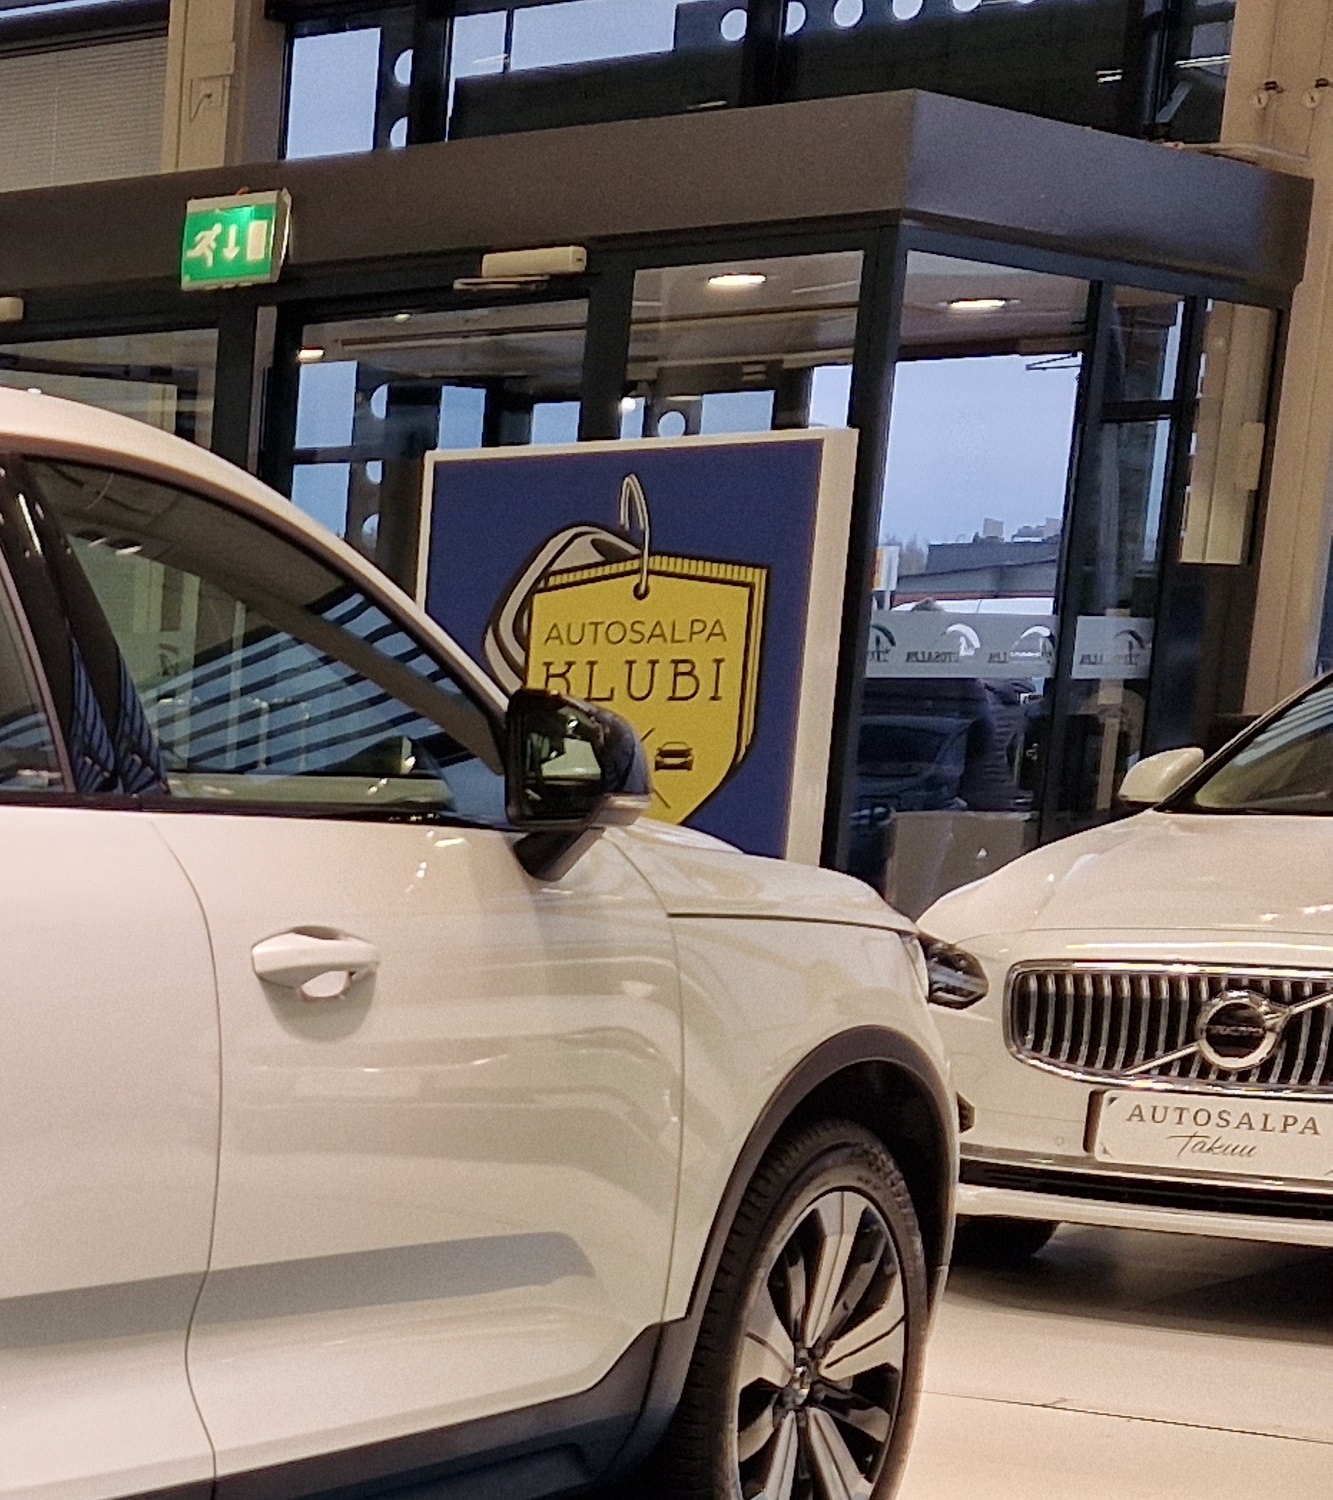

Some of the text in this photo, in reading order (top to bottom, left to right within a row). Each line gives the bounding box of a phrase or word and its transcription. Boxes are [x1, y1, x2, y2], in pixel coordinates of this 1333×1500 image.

[544, 619, 728, 645] AUTOSALPA
[542, 658, 726, 701] KLUBI
[1126, 1103, 1321, 1136] AUTOSALPA
[1166, 1131, 1258, 1158] Takuu
